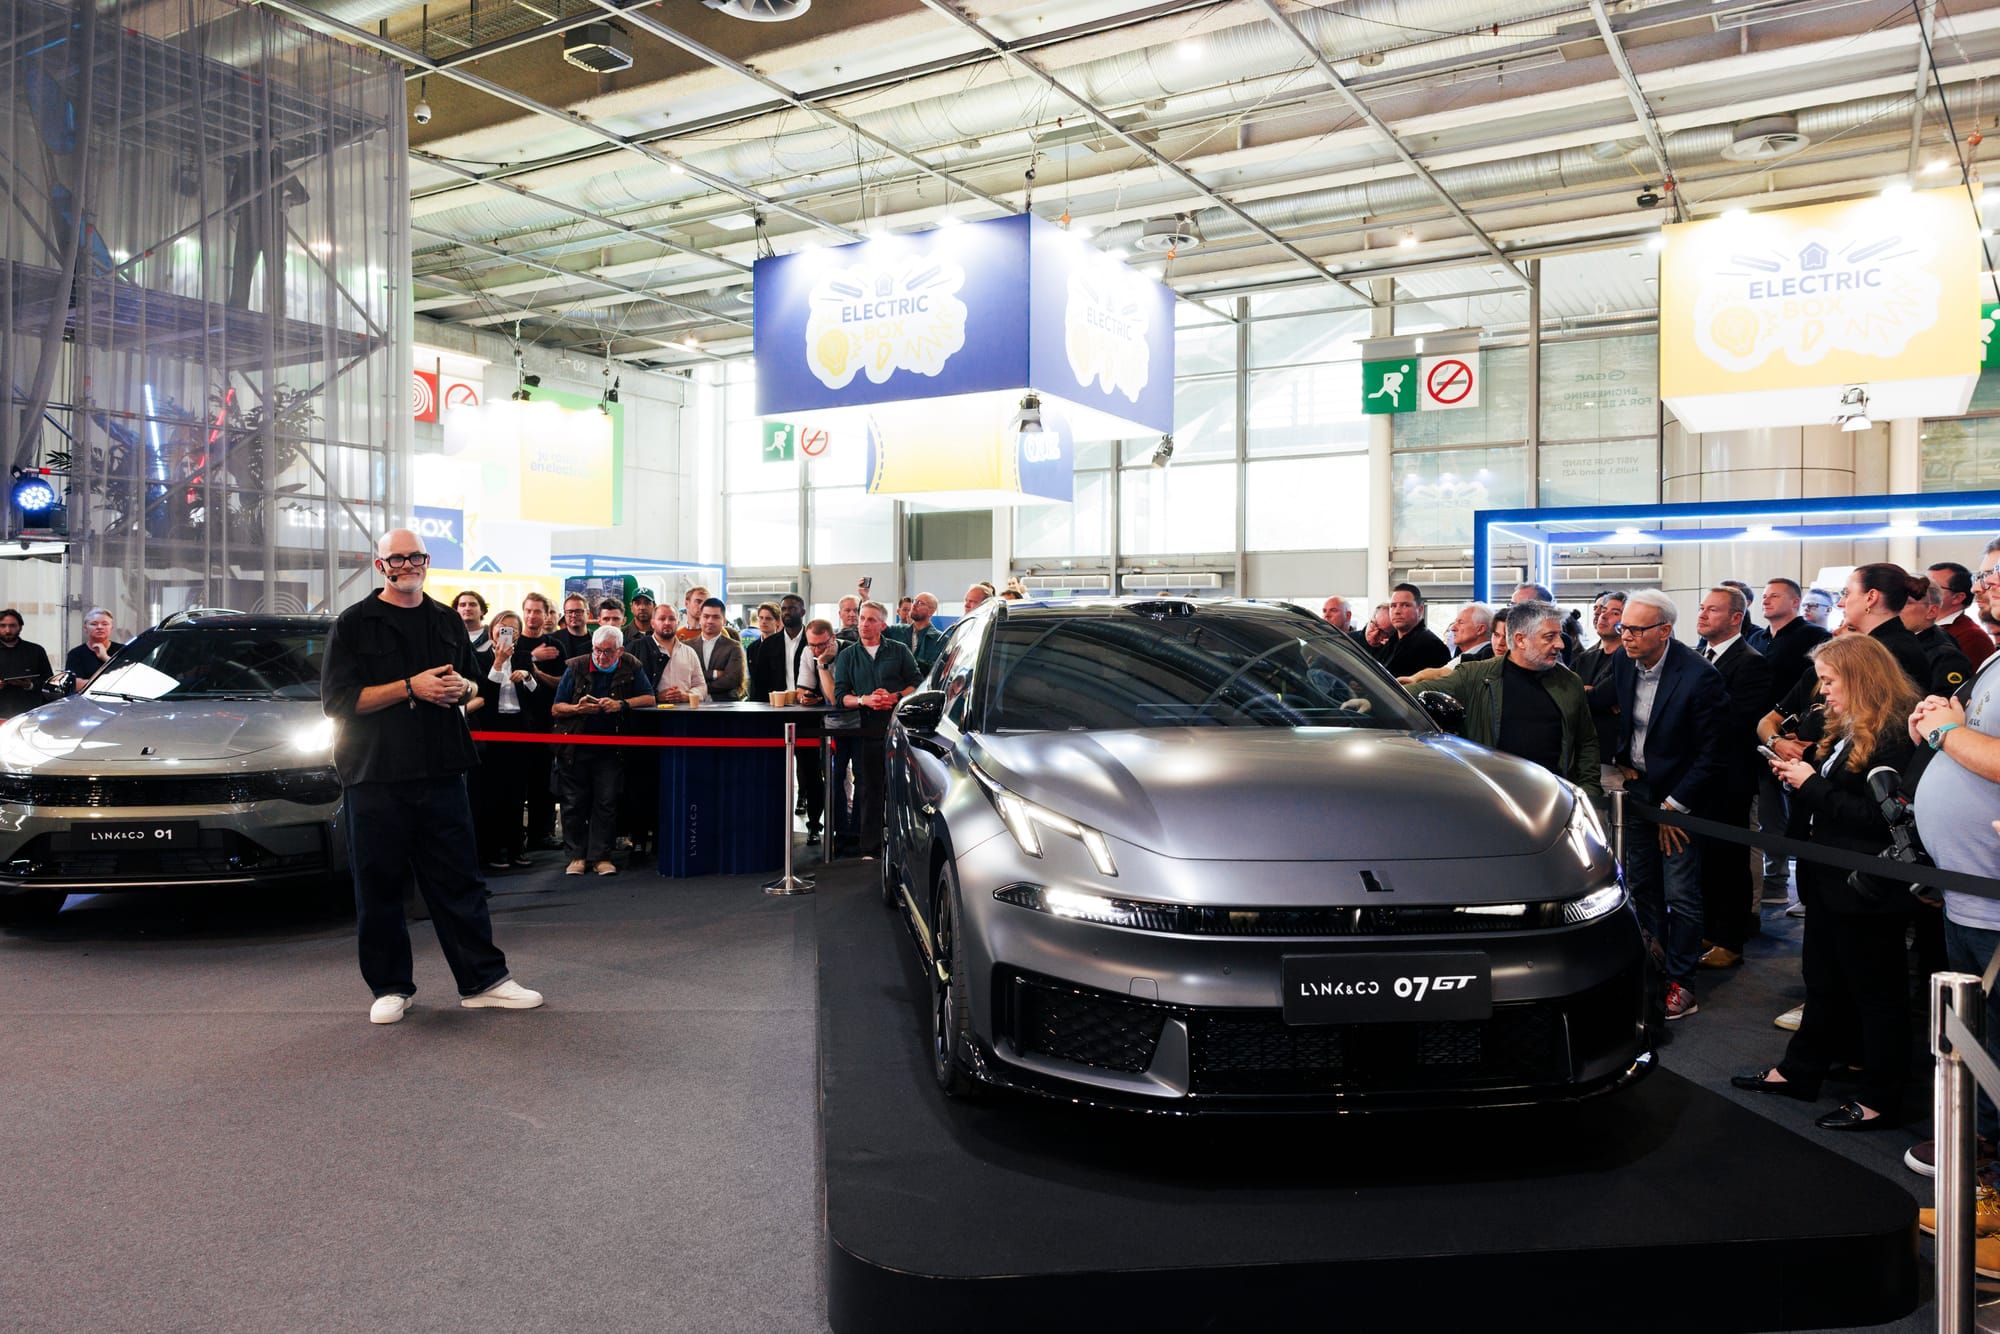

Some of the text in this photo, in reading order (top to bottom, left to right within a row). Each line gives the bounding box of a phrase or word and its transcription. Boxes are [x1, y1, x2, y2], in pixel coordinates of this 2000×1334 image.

[1749, 268, 1881, 300] ELECTRIC
[842, 295, 928, 323] ELECTRIC
[1784, 298, 1845, 320] BOX
[863, 321, 904, 341] BOX
[1087, 306, 1133, 341] ELECTRIC
[154, 829, 172, 840] 01
